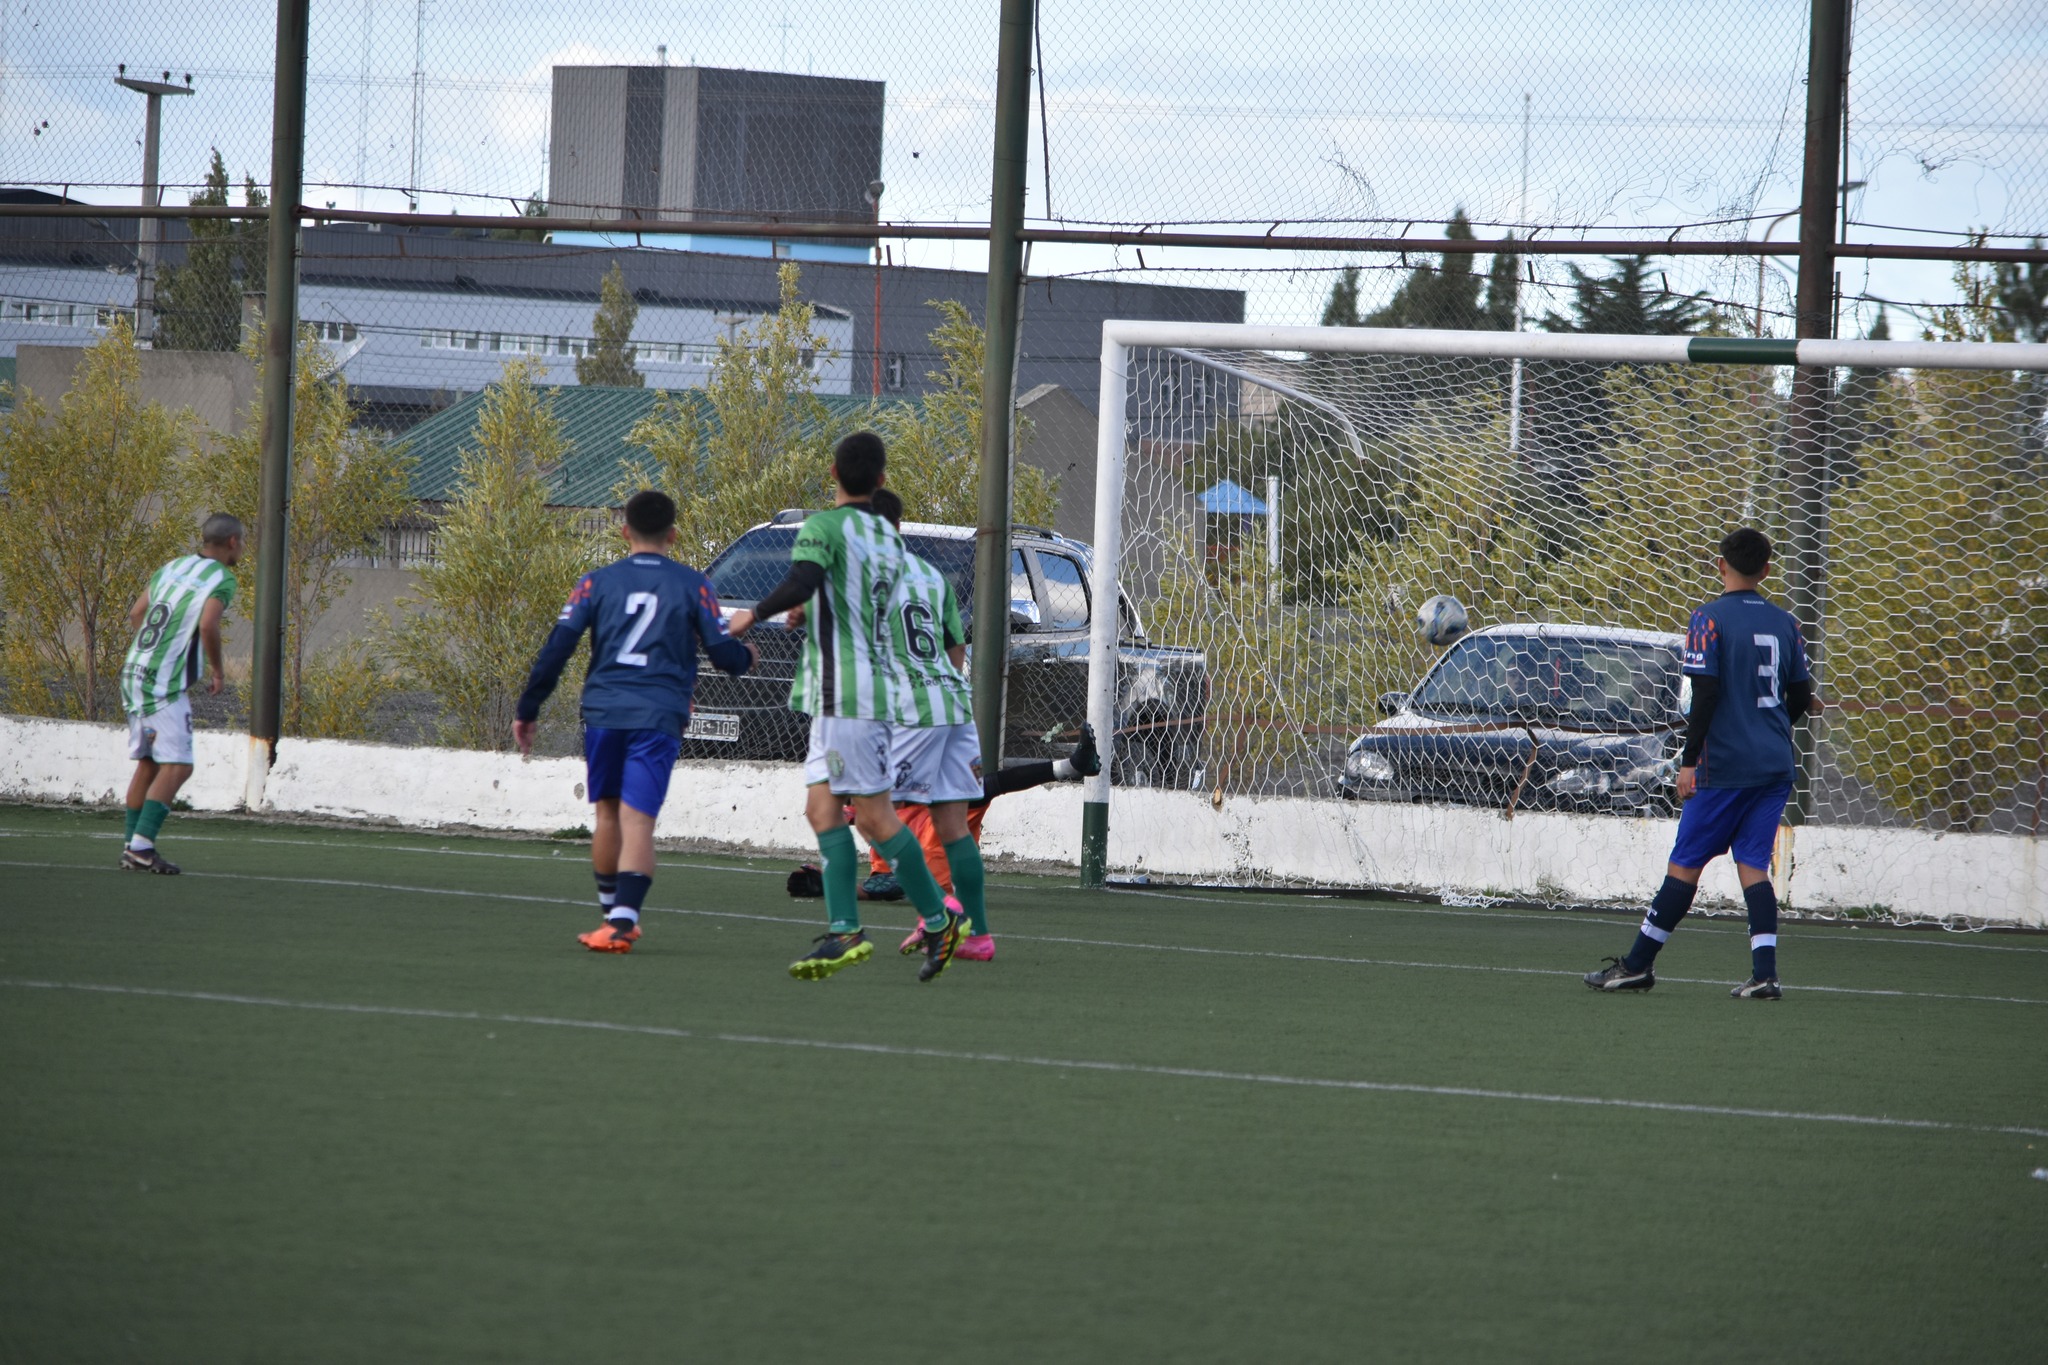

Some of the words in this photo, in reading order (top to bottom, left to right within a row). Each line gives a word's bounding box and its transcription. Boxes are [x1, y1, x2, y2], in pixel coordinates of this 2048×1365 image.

[136, 601, 172, 653] 8
[616, 592, 658, 667] 2
[900, 600, 940, 663] 6
[1753, 634, 1781, 708] 3
[716, 721, 737, 736] 105
